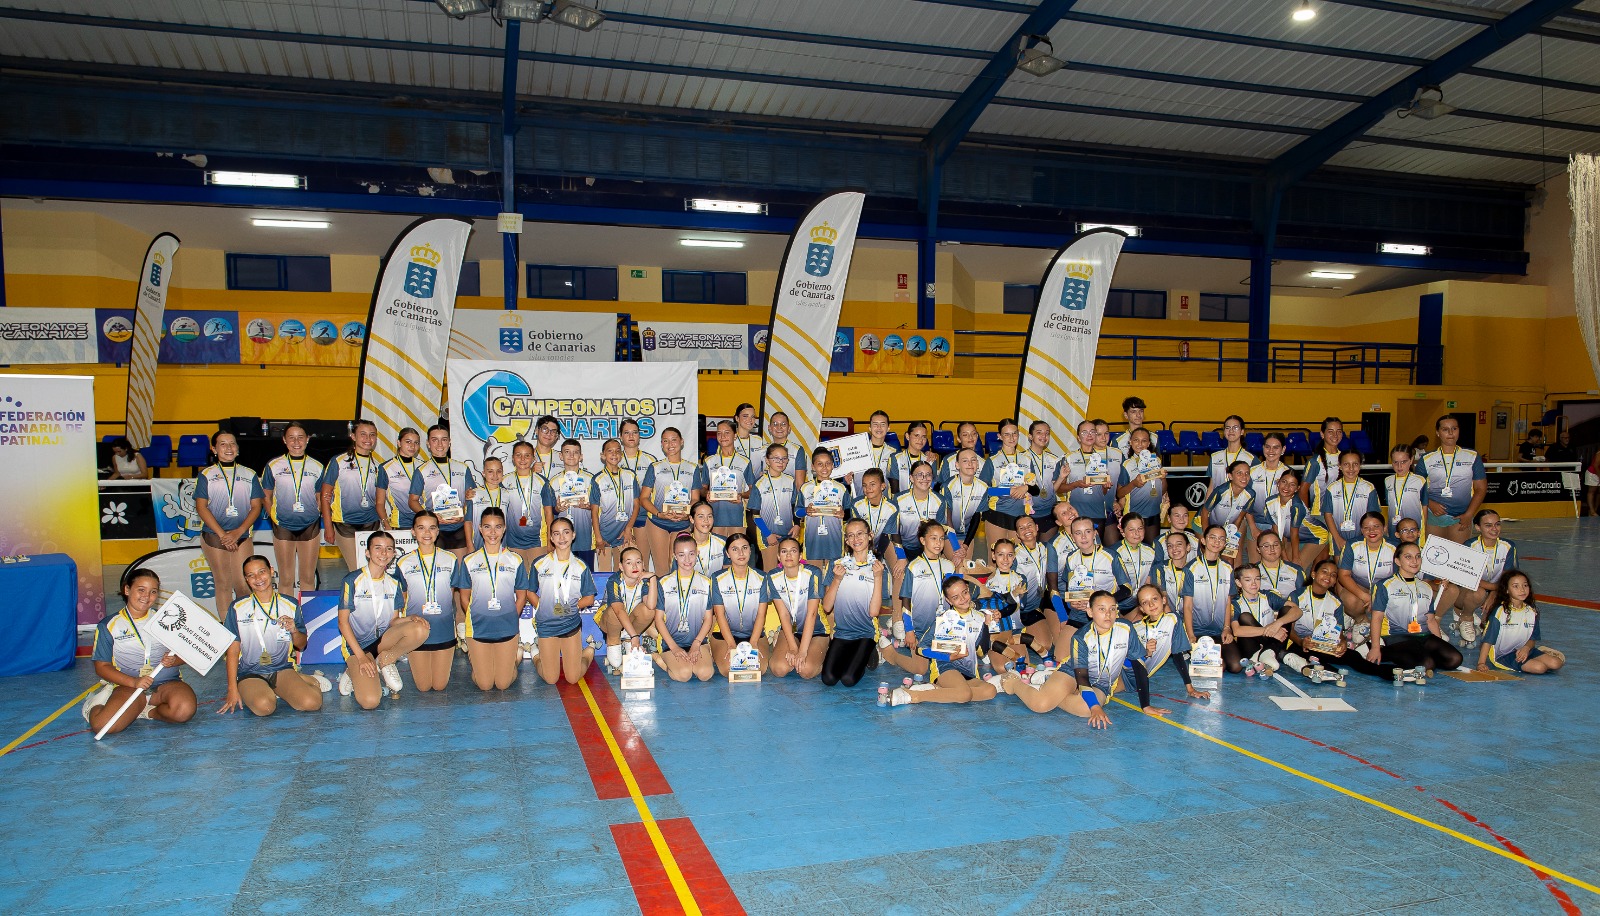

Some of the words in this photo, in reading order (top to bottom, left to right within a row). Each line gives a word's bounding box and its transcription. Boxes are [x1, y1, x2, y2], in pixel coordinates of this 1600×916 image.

[795, 280, 832, 291] Gobierno
[790, 288, 799, 296] de
[801, 290, 835, 300] Canarias
[393, 299, 439, 316] Gobierno
[386, 306, 398, 316] de
[401, 310, 443, 327] Canarias
[1050, 312, 1089, 326] Gobierno
[0, 323, 88, 331] MPEONATOS
[1043, 321, 1054, 329] de
[1056, 322, 1092, 335] Canarias
[3, 330, 88, 340] CANARIAS
[528, 330, 583, 340] Gobierno
[659, 333, 742, 341] CAMPEONATOS
[527, 341, 541, 351] de
[545, 342, 596, 353] Canarias
[659, 340, 677, 348] DE
[678, 340, 742, 349] CANARIAS
[493, 396, 656, 417] CAMPEONATOS
[657, 397, 686, 415] DE
[0, 410, 85, 421] FEDERACIÓN
[0, 424, 62, 433] CANARIA
[66, 424, 83, 433] DE
[1521, 481, 1561, 489] GranCanaria
[198, 626, 211, 637] CLUB
[182, 625, 194, 635] SAN
[194, 632, 219, 654] FERNANDO
[178, 632, 192, 645] GRAN
[191, 643, 213, 661] CANARIA
